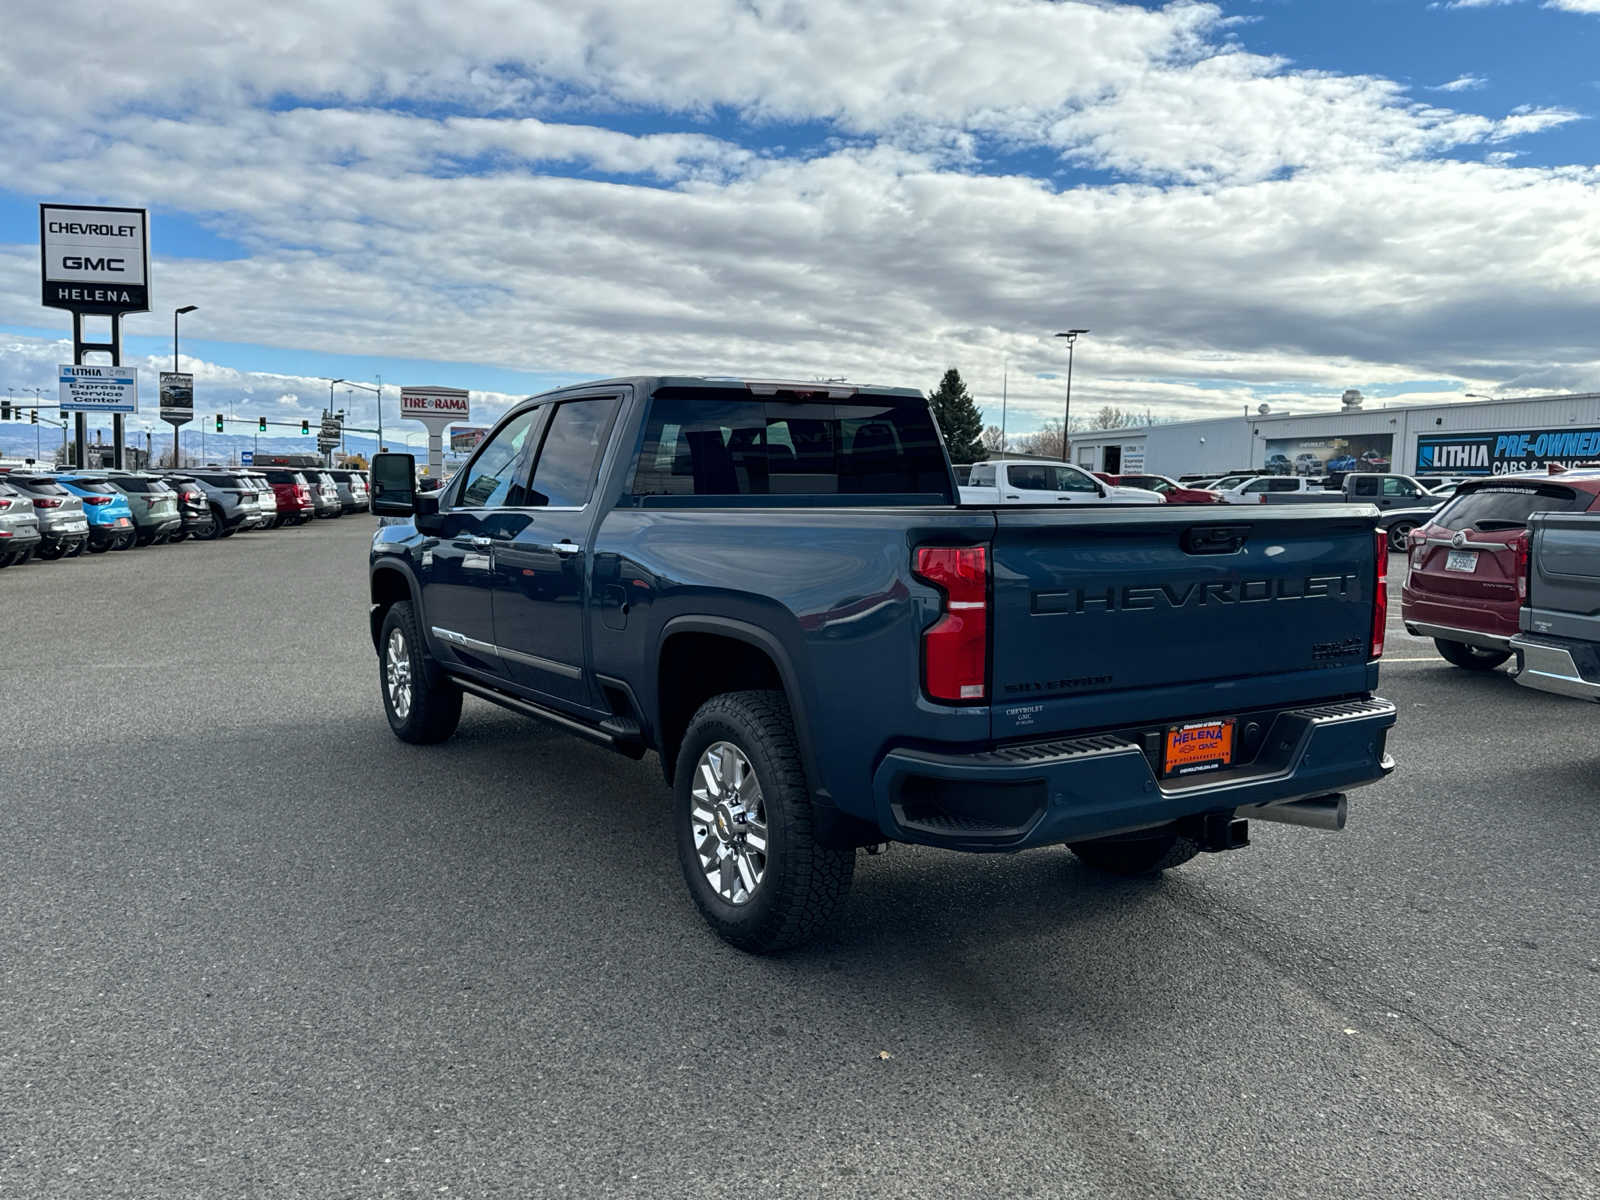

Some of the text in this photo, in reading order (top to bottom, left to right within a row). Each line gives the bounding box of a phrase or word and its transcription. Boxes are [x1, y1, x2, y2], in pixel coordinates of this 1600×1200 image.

[49, 222, 136, 237] CHEVROLET
[63, 256, 125, 272] GMC
[58, 288, 130, 303] HELENA
[72, 368, 102, 377] LITHIA
[69, 383, 125, 391] Express
[402, 397, 468, 410] TIRE RAMA
[1433, 432, 1600, 467] LITHIA PRE-OWNED
[1492, 461, 1526, 475] CARS
[1030, 575, 1357, 617] CHEVROLET
[1005, 675, 1112, 693] SILVERADO
[1173, 727, 1223, 748] HELENA
